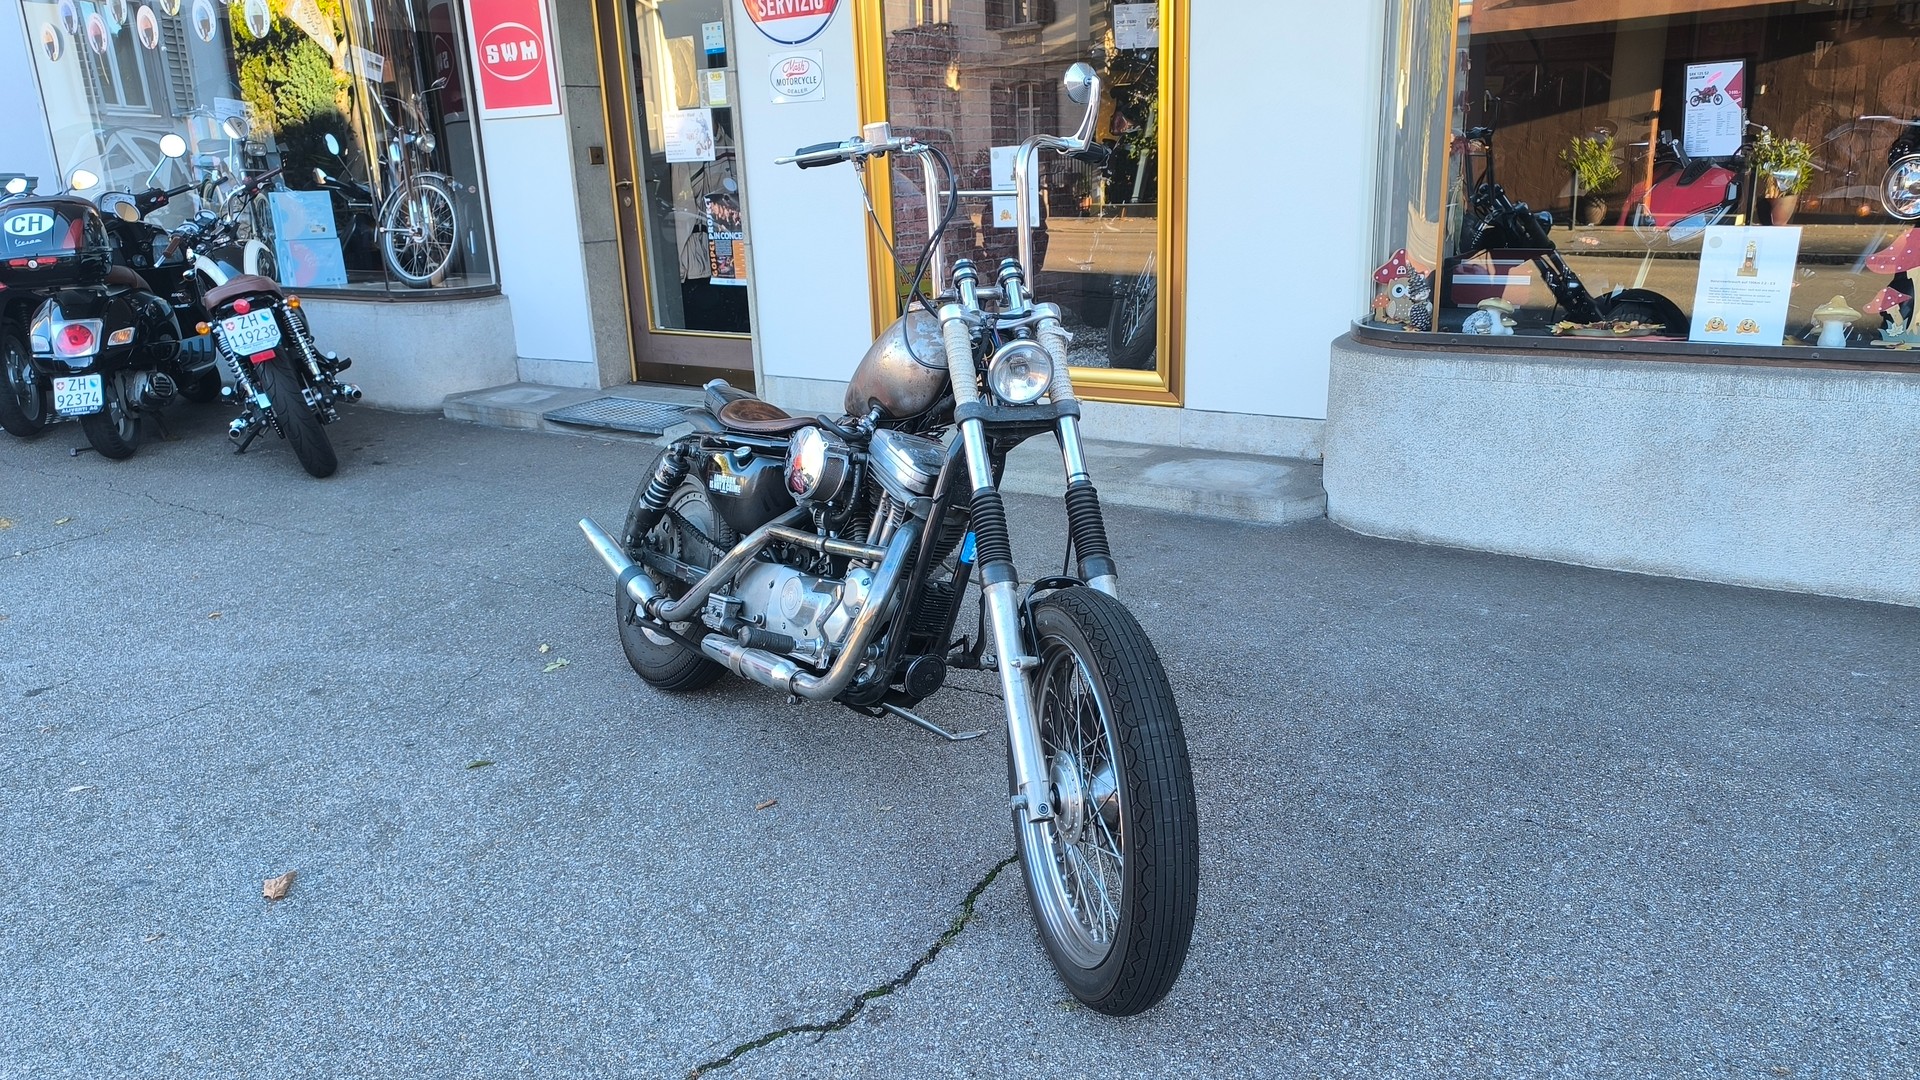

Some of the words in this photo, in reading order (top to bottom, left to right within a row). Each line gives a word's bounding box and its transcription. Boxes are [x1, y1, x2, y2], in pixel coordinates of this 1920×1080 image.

[485, 39, 538, 64] SWM
[776, 76, 817, 86] MOTORCYCLE
[12, 216, 43, 233] CH
[704, 196, 715, 240] PROJECT
[709, 241, 719, 277] GOSPEL
[238, 314, 259, 330] ZH
[231, 324, 279, 347] 119238
[69, 378, 86, 391] ZH
[57, 391, 99, 407] 92374
